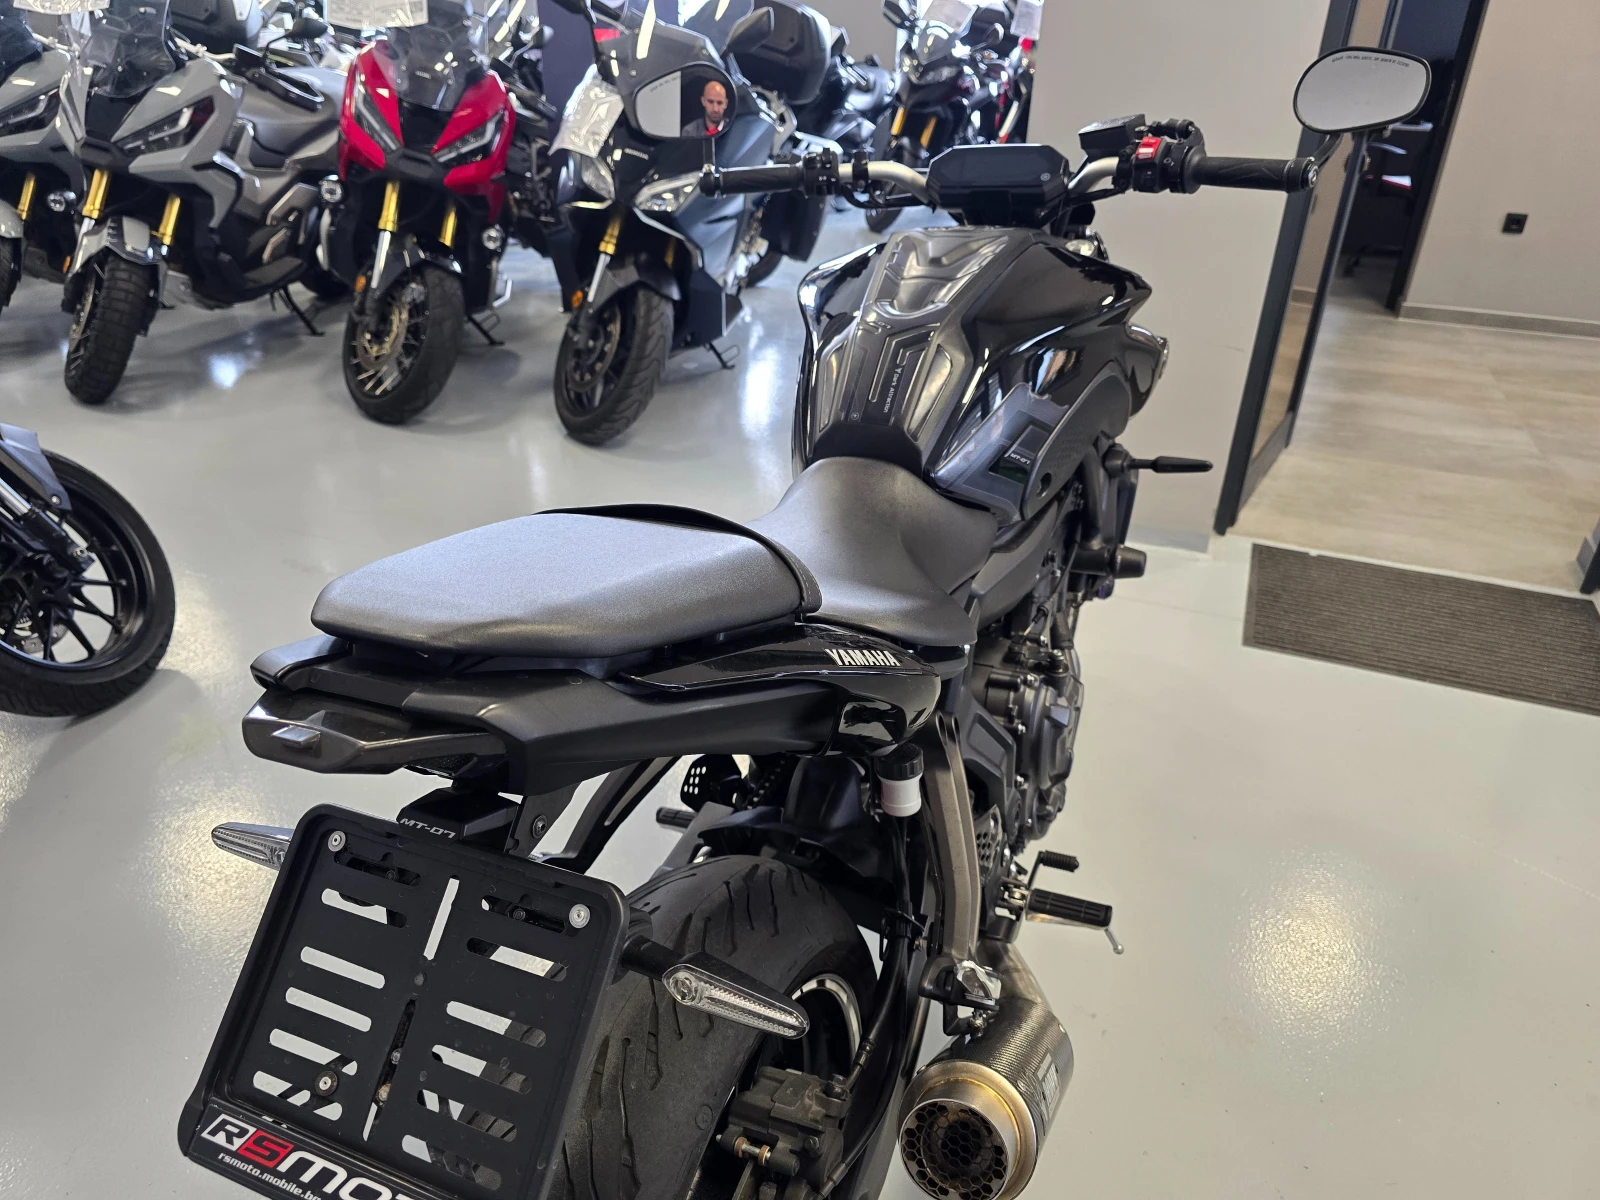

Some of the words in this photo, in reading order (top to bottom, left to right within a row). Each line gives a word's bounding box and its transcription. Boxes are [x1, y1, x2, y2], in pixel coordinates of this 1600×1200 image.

[1010, 453, 1031, 464] MT-07
[824, 648, 902, 667] YAMAHA
[400, 818, 456, 838] MT-07
